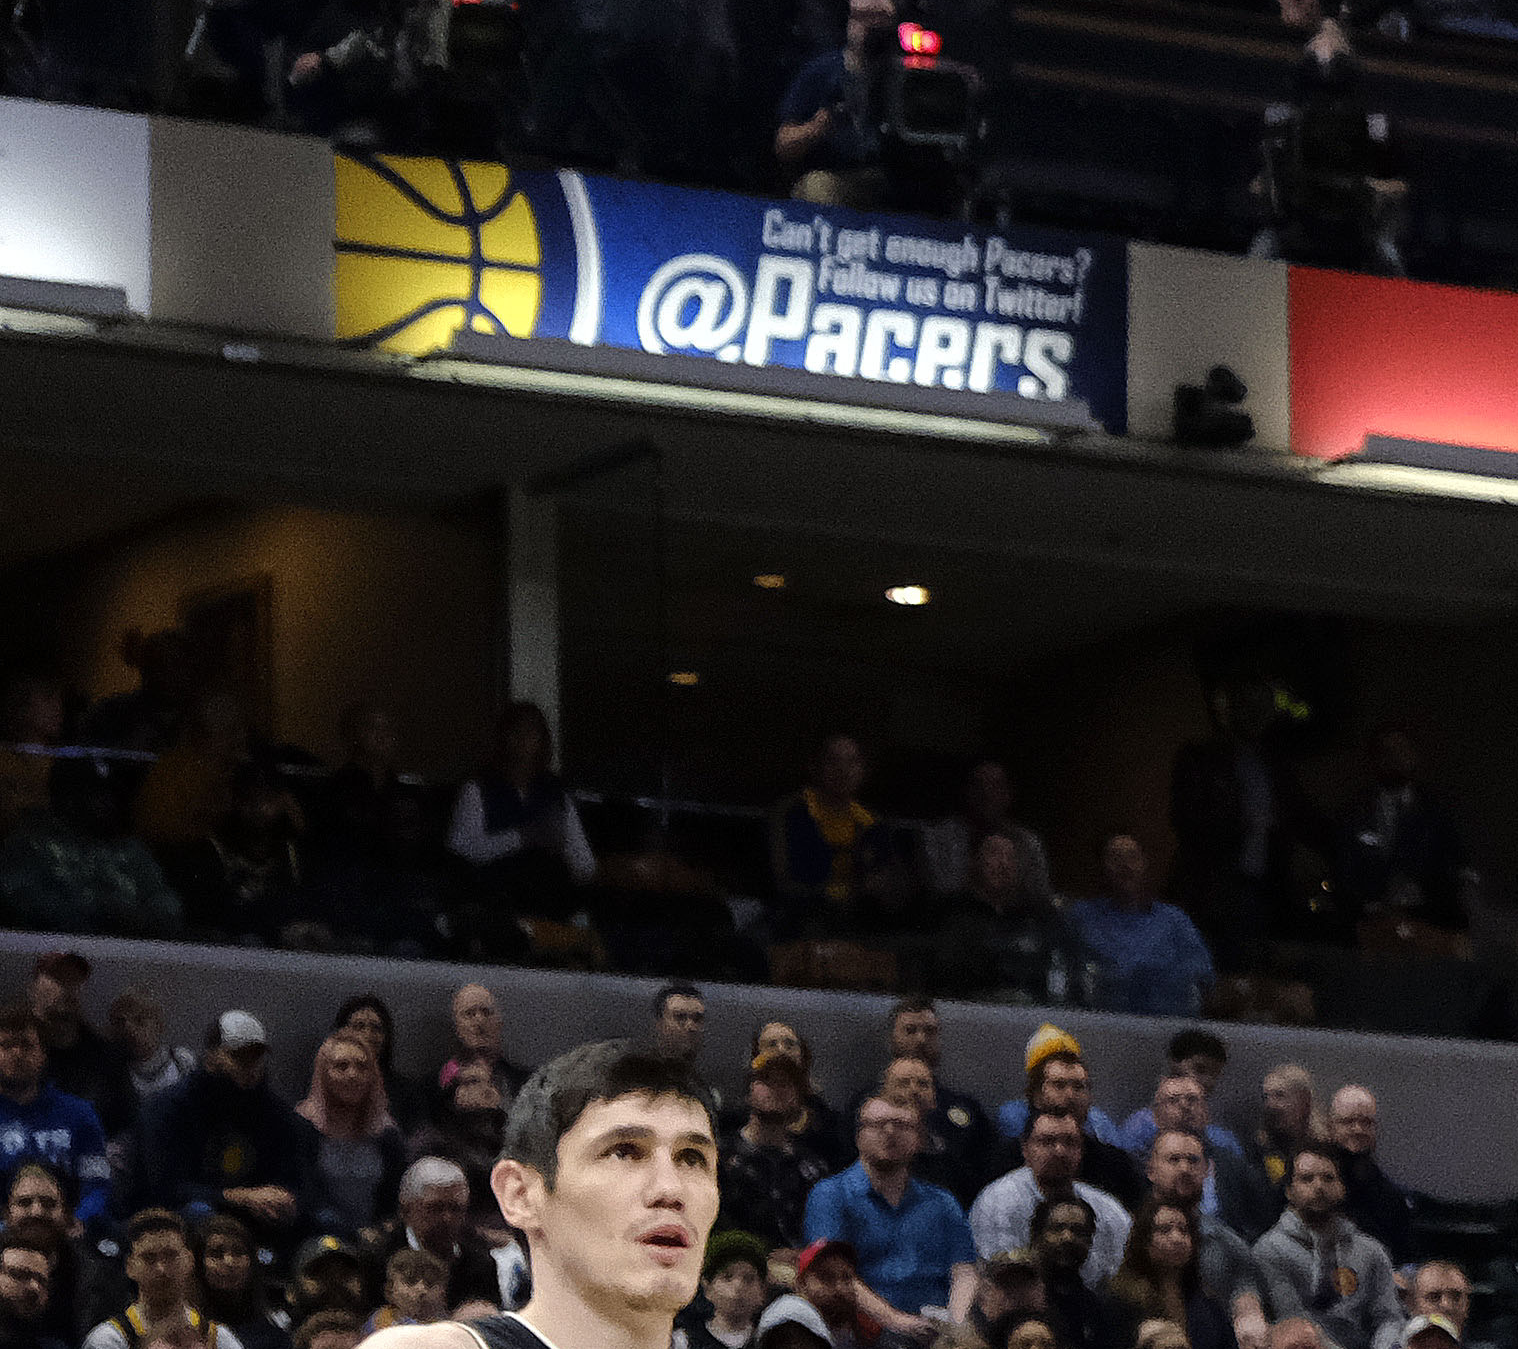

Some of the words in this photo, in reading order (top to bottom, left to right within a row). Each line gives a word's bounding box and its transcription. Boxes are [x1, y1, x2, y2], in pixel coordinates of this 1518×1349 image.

[762, 207, 833, 252] Can't
[818, 253, 902, 302] Follow
[636, 252, 1076, 402] @Pacers
